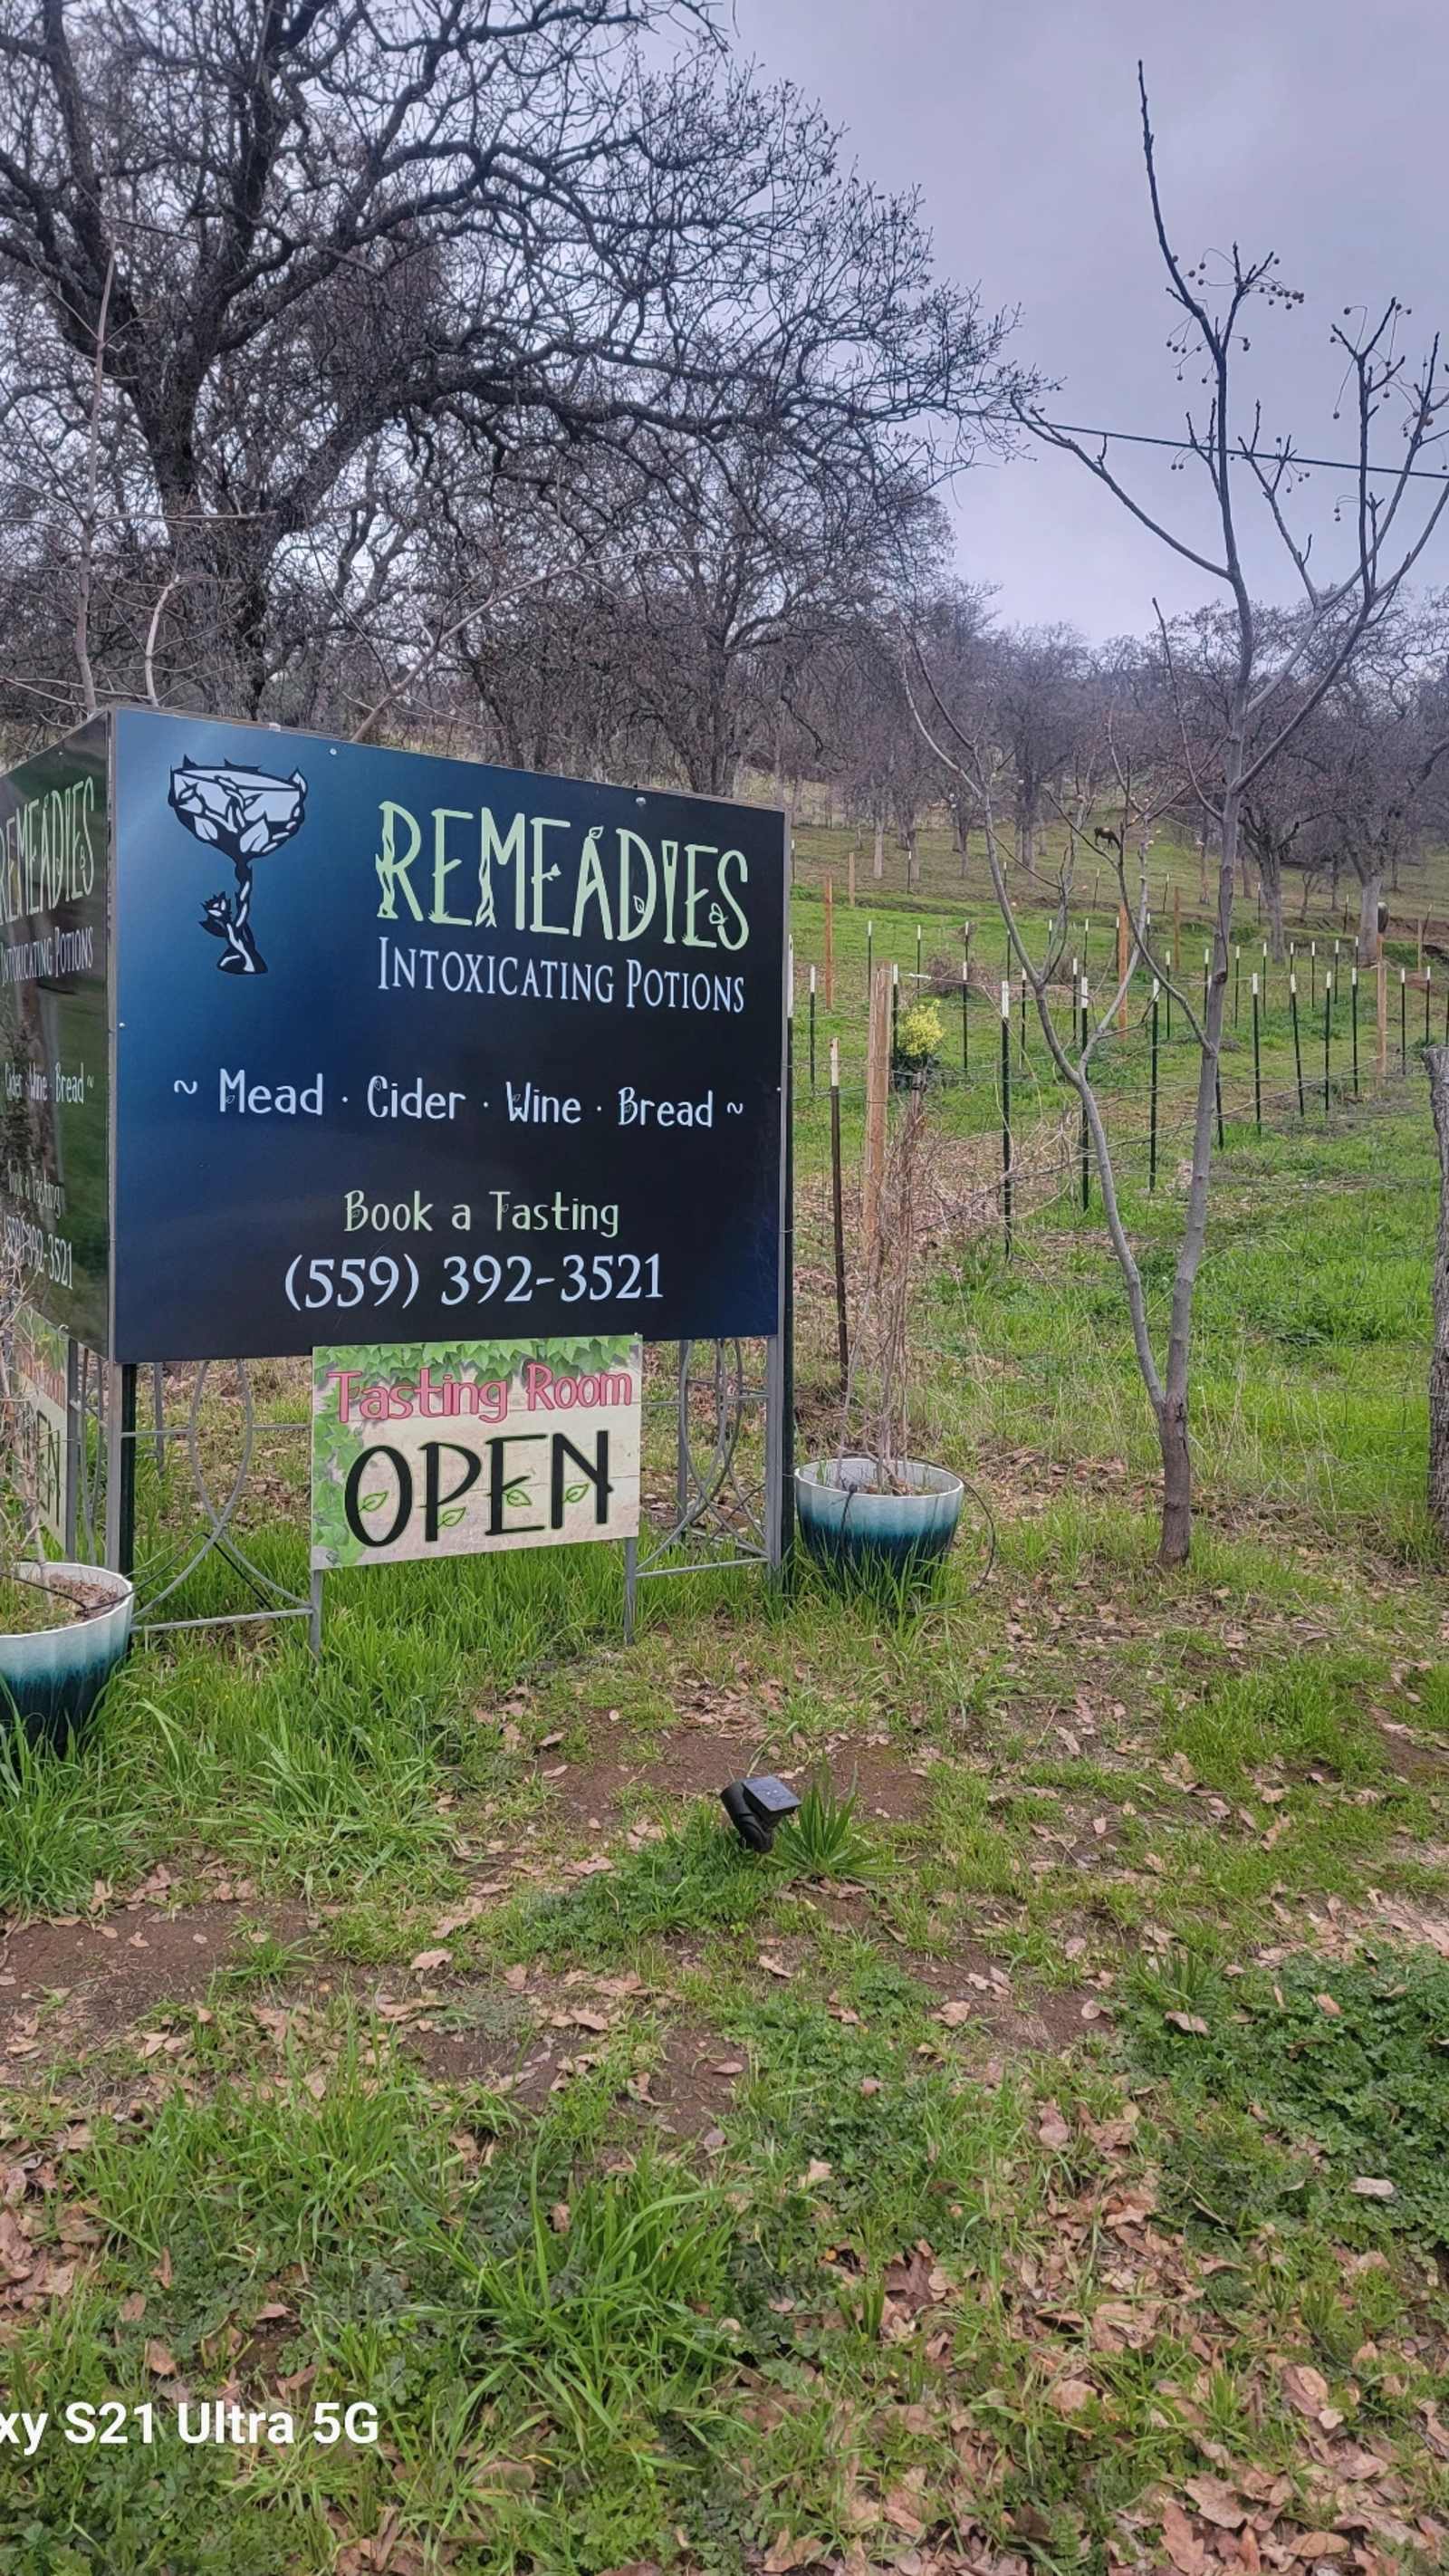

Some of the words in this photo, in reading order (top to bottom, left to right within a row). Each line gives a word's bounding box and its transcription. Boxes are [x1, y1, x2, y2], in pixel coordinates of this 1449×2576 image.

[375, 801, 750, 951] REMEADIES
[54, 927, 93, 978] POTIONS
[378, 937, 614, 1004] INTOXICATING
[626, 959, 744, 1014] POTIONS
[55, 1061, 84, 1104] Bread
[219, 1068, 323, 1116] Mead
[367, 1075, 465, 1120] Cider
[505, 1081, 581, 1123] Wine
[618, 1086, 713, 1128] Bread
[344, 1189, 434, 1232] Book
[451, 1203, 472, 1232] a
[489, 1191, 619, 1238] Tasting
[284, 1253, 419, 1312] (559)
[441, 1253, 664, 1306] 392-3521
[326, 1367, 508, 1424] Tasting
[526, 1361, 633, 1412] Room
[344, 1430, 614, 1548] OPEN
